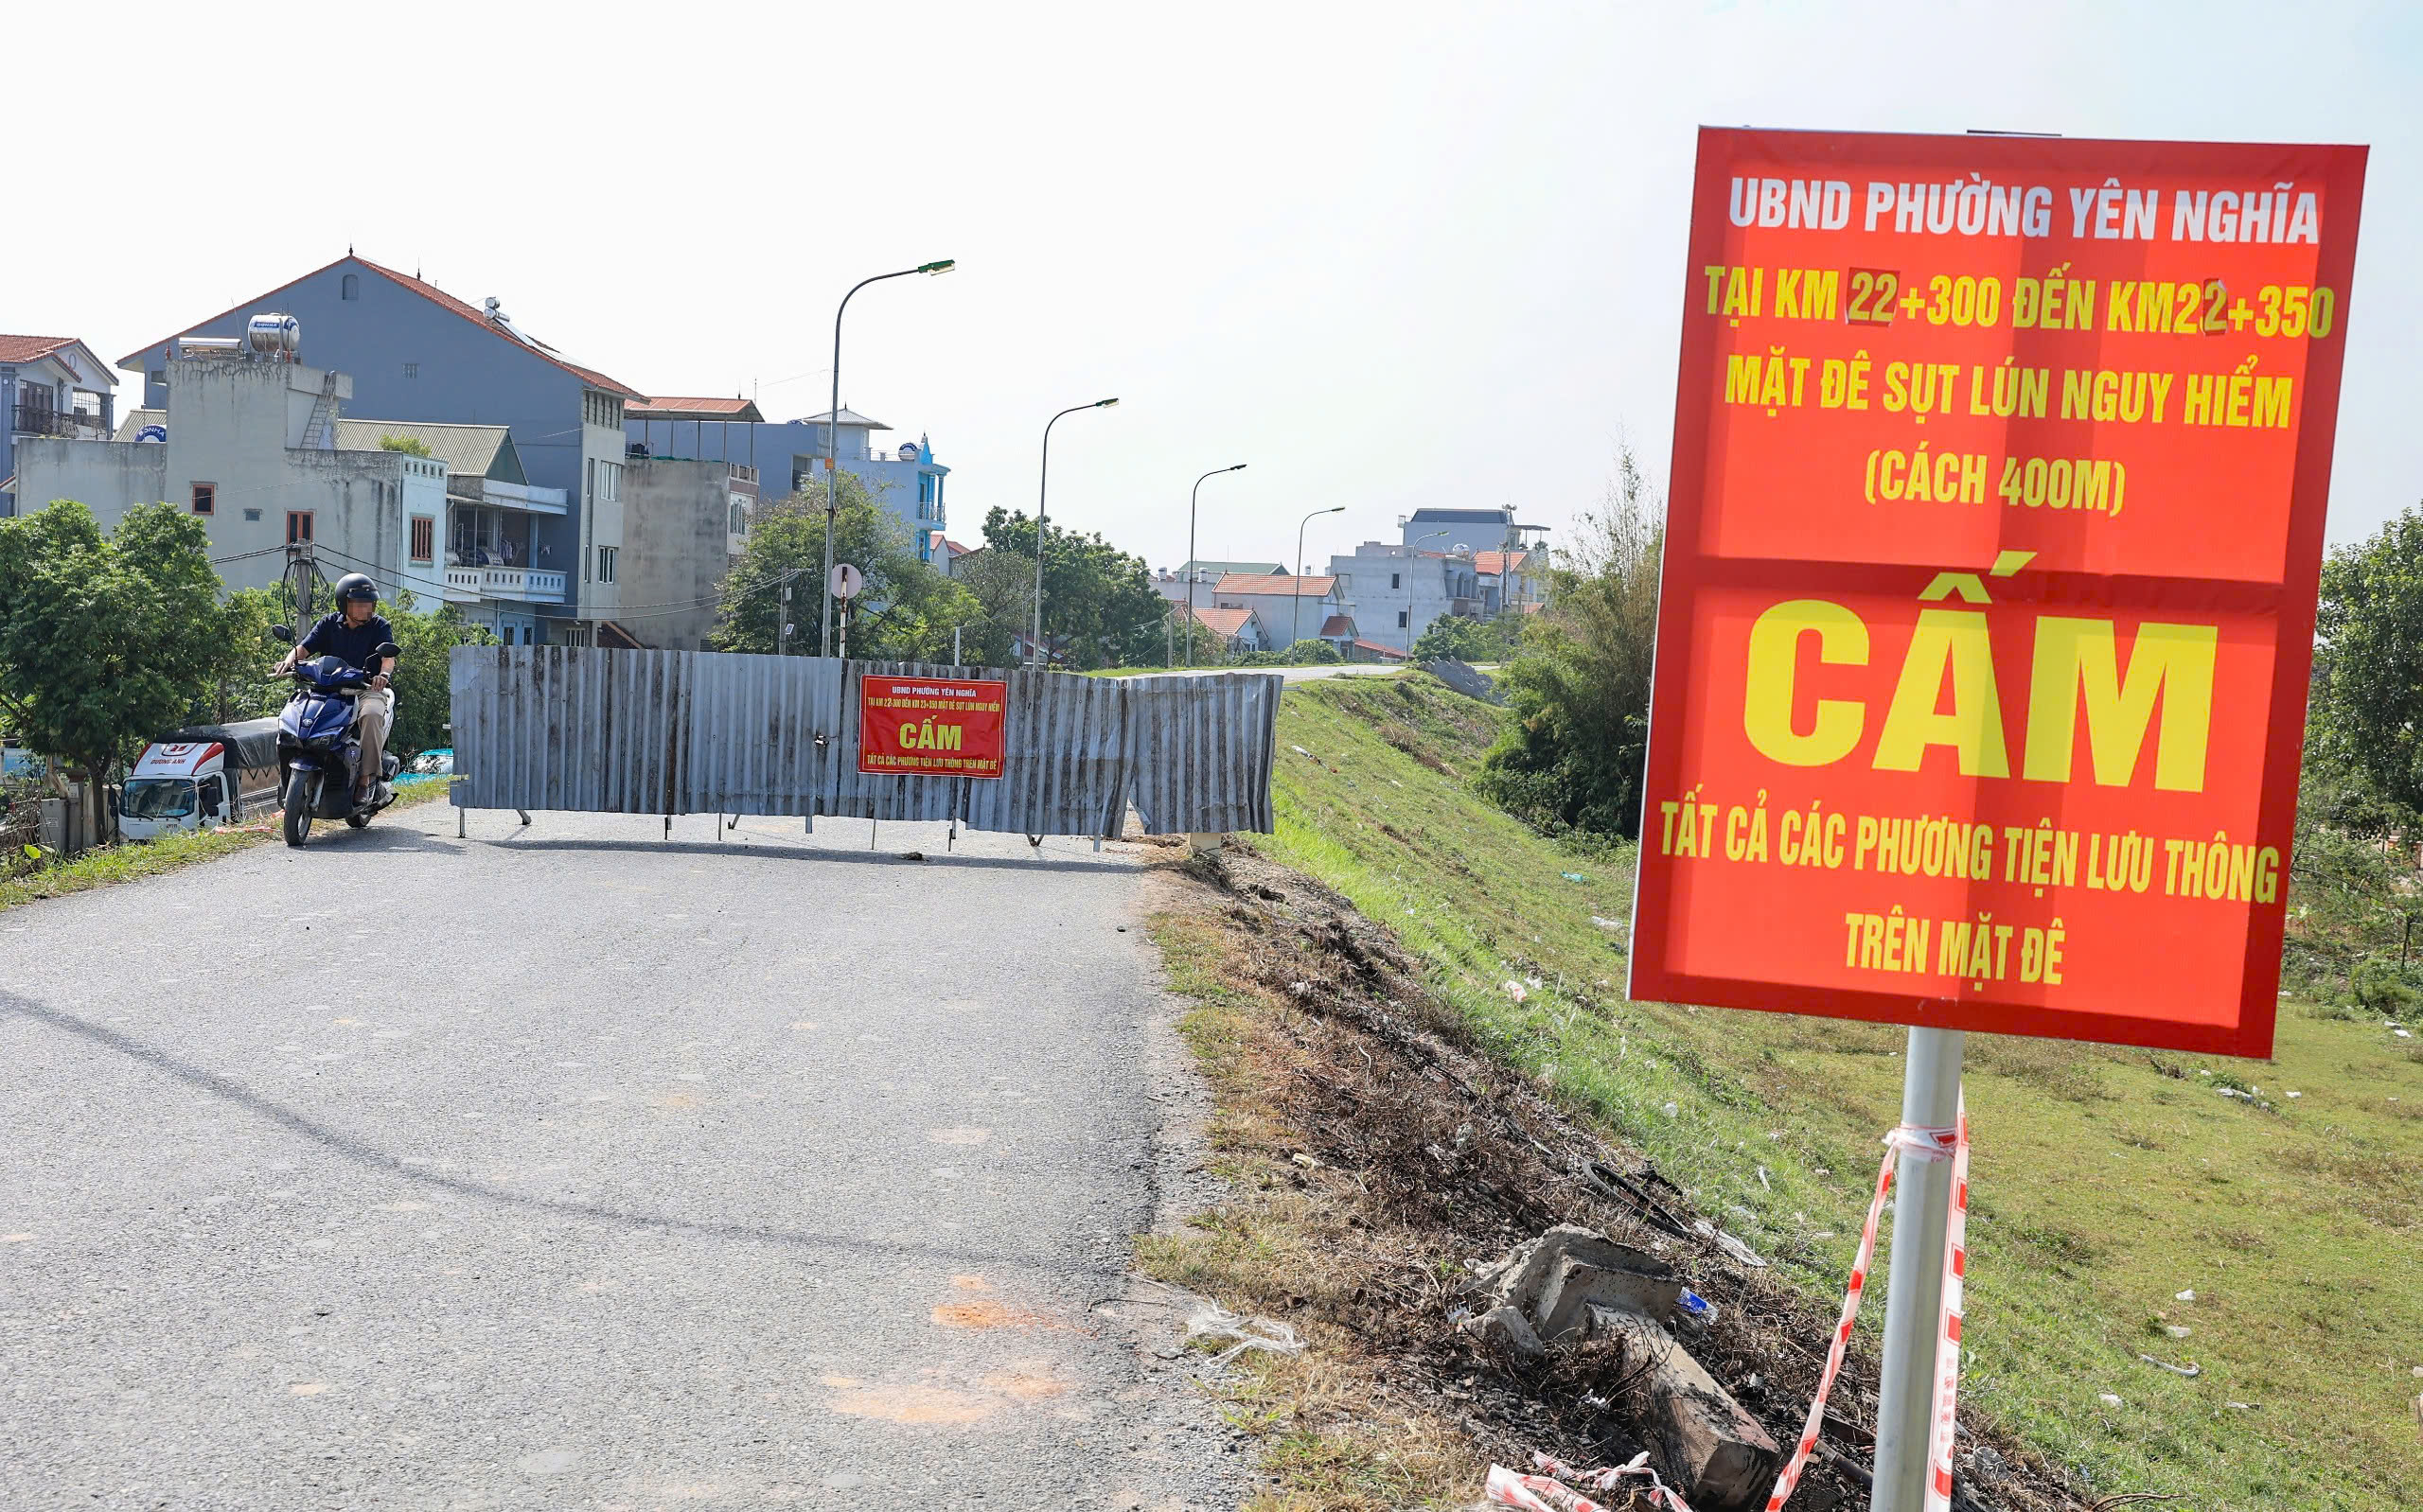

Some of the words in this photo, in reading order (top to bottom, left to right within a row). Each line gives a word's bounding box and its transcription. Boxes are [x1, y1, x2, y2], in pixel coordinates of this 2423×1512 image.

[1729, 177, 1852, 230] UBND
[1865, 171, 2053, 237] PHƯỜNG
[2070, 177, 2159, 240] YÊN
[2171, 181, 2319, 244] NGHĨA
[1705, 265, 1763, 326] TẠI
[1775, 269, 1840, 320] KM
[1845, 273, 2002, 328] 22+300
[2012, 261, 2096, 331] ĐẾN
[2107, 279, 2335, 339] KM22+350
[1724, 344, 1812, 417] MẶT
[1820, 349, 1871, 411] ĐÊ
[1883, 361, 1961, 424] SỤT
[1970, 355, 2049, 418] LÚN
[2060, 370, 2173, 423] NGUY
[2184, 354, 2292, 428] HIỂM
[1865, 439, 1988, 504] (CÁCH
[1999, 457, 2125, 517] 400M)
[892, 686, 911, 694] UBND
[911, 686, 940, 695] PHƯỜNG
[941, 688, 955, 696] YÊN
[956, 689, 977, 697] NGHĨA
[1743, 550, 2219, 792] CẤM
[899, 714, 963, 750] CẤM
[1660, 782, 1719, 858] TẤT
[1724, 788, 1768, 863] CẢ
[1778, 800, 1846, 869] CÁC
[1854, 814, 1992, 881] PHƯƠNG
[2005, 817, 2078, 898] TIỆN
[2087, 831, 2154, 894] LƯU
[2166, 830, 2279, 904] THÔNG
[1846, 904, 1930, 974] TRÊN
[1938, 911, 2013, 992] MẶT
[2021, 917, 2066, 985] ĐÊ
